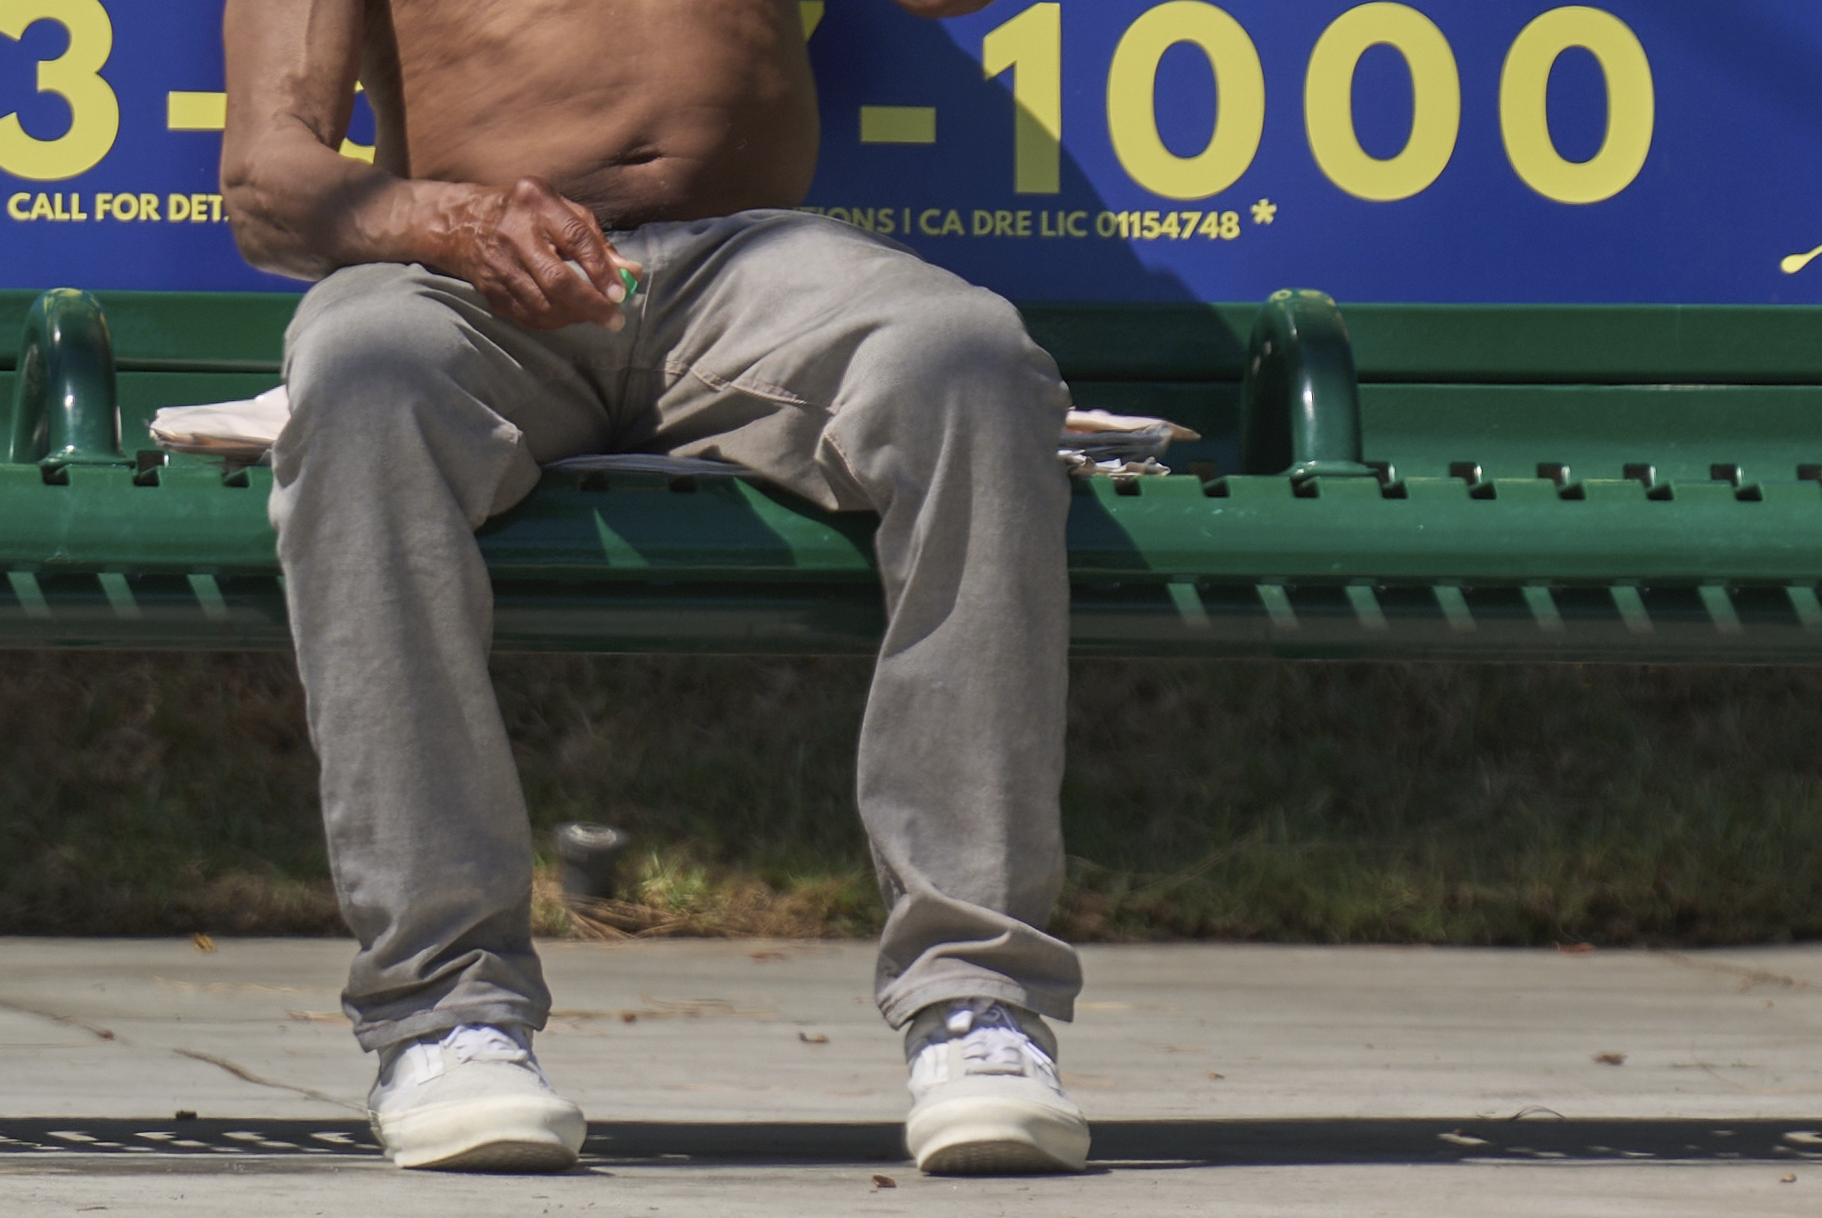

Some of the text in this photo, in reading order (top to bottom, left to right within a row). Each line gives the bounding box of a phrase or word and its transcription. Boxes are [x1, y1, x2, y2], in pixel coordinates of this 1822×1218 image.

[7, 191, 88, 221] CALL
[95, 193, 161, 222] FOR
[168, 193, 230, 222] DET
[793, 206, 896, 235] ONS
[918, 208, 965, 237] CA
[972, 209, 1032, 237] DRE
[1040, 210, 1088, 238] LIC
